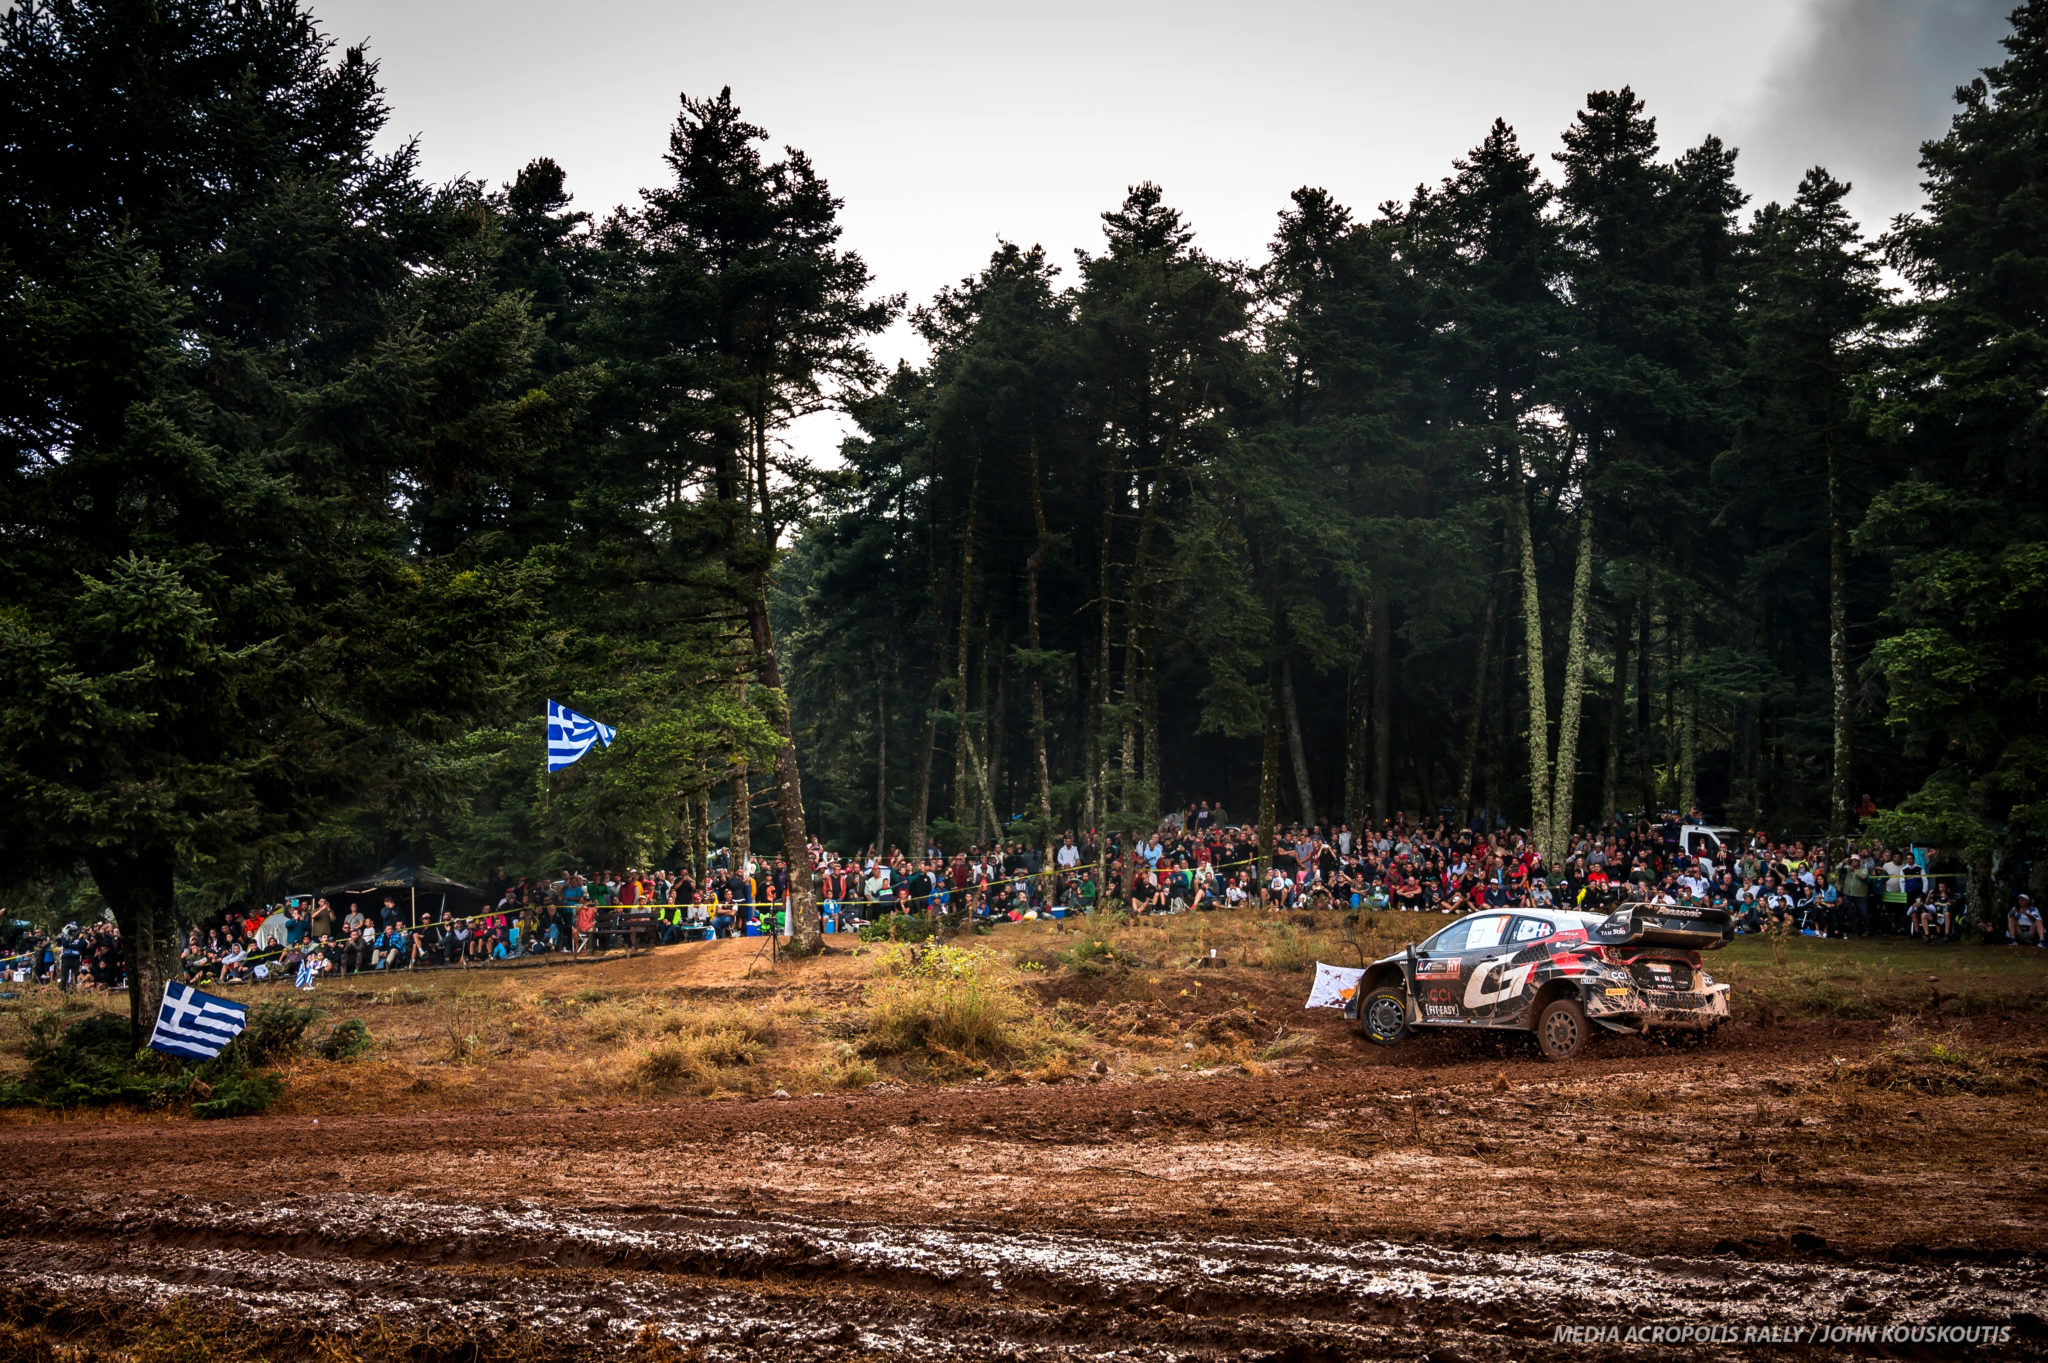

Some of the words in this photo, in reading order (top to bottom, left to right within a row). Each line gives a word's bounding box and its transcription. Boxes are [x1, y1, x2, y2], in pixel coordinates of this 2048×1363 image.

[1656, 906, 1702, 918] Panasonic
[1447, 959, 1460, 972] HY
[1611, 971, 1628, 980] CCI
[1429, 988, 1451, 1002] CCI
